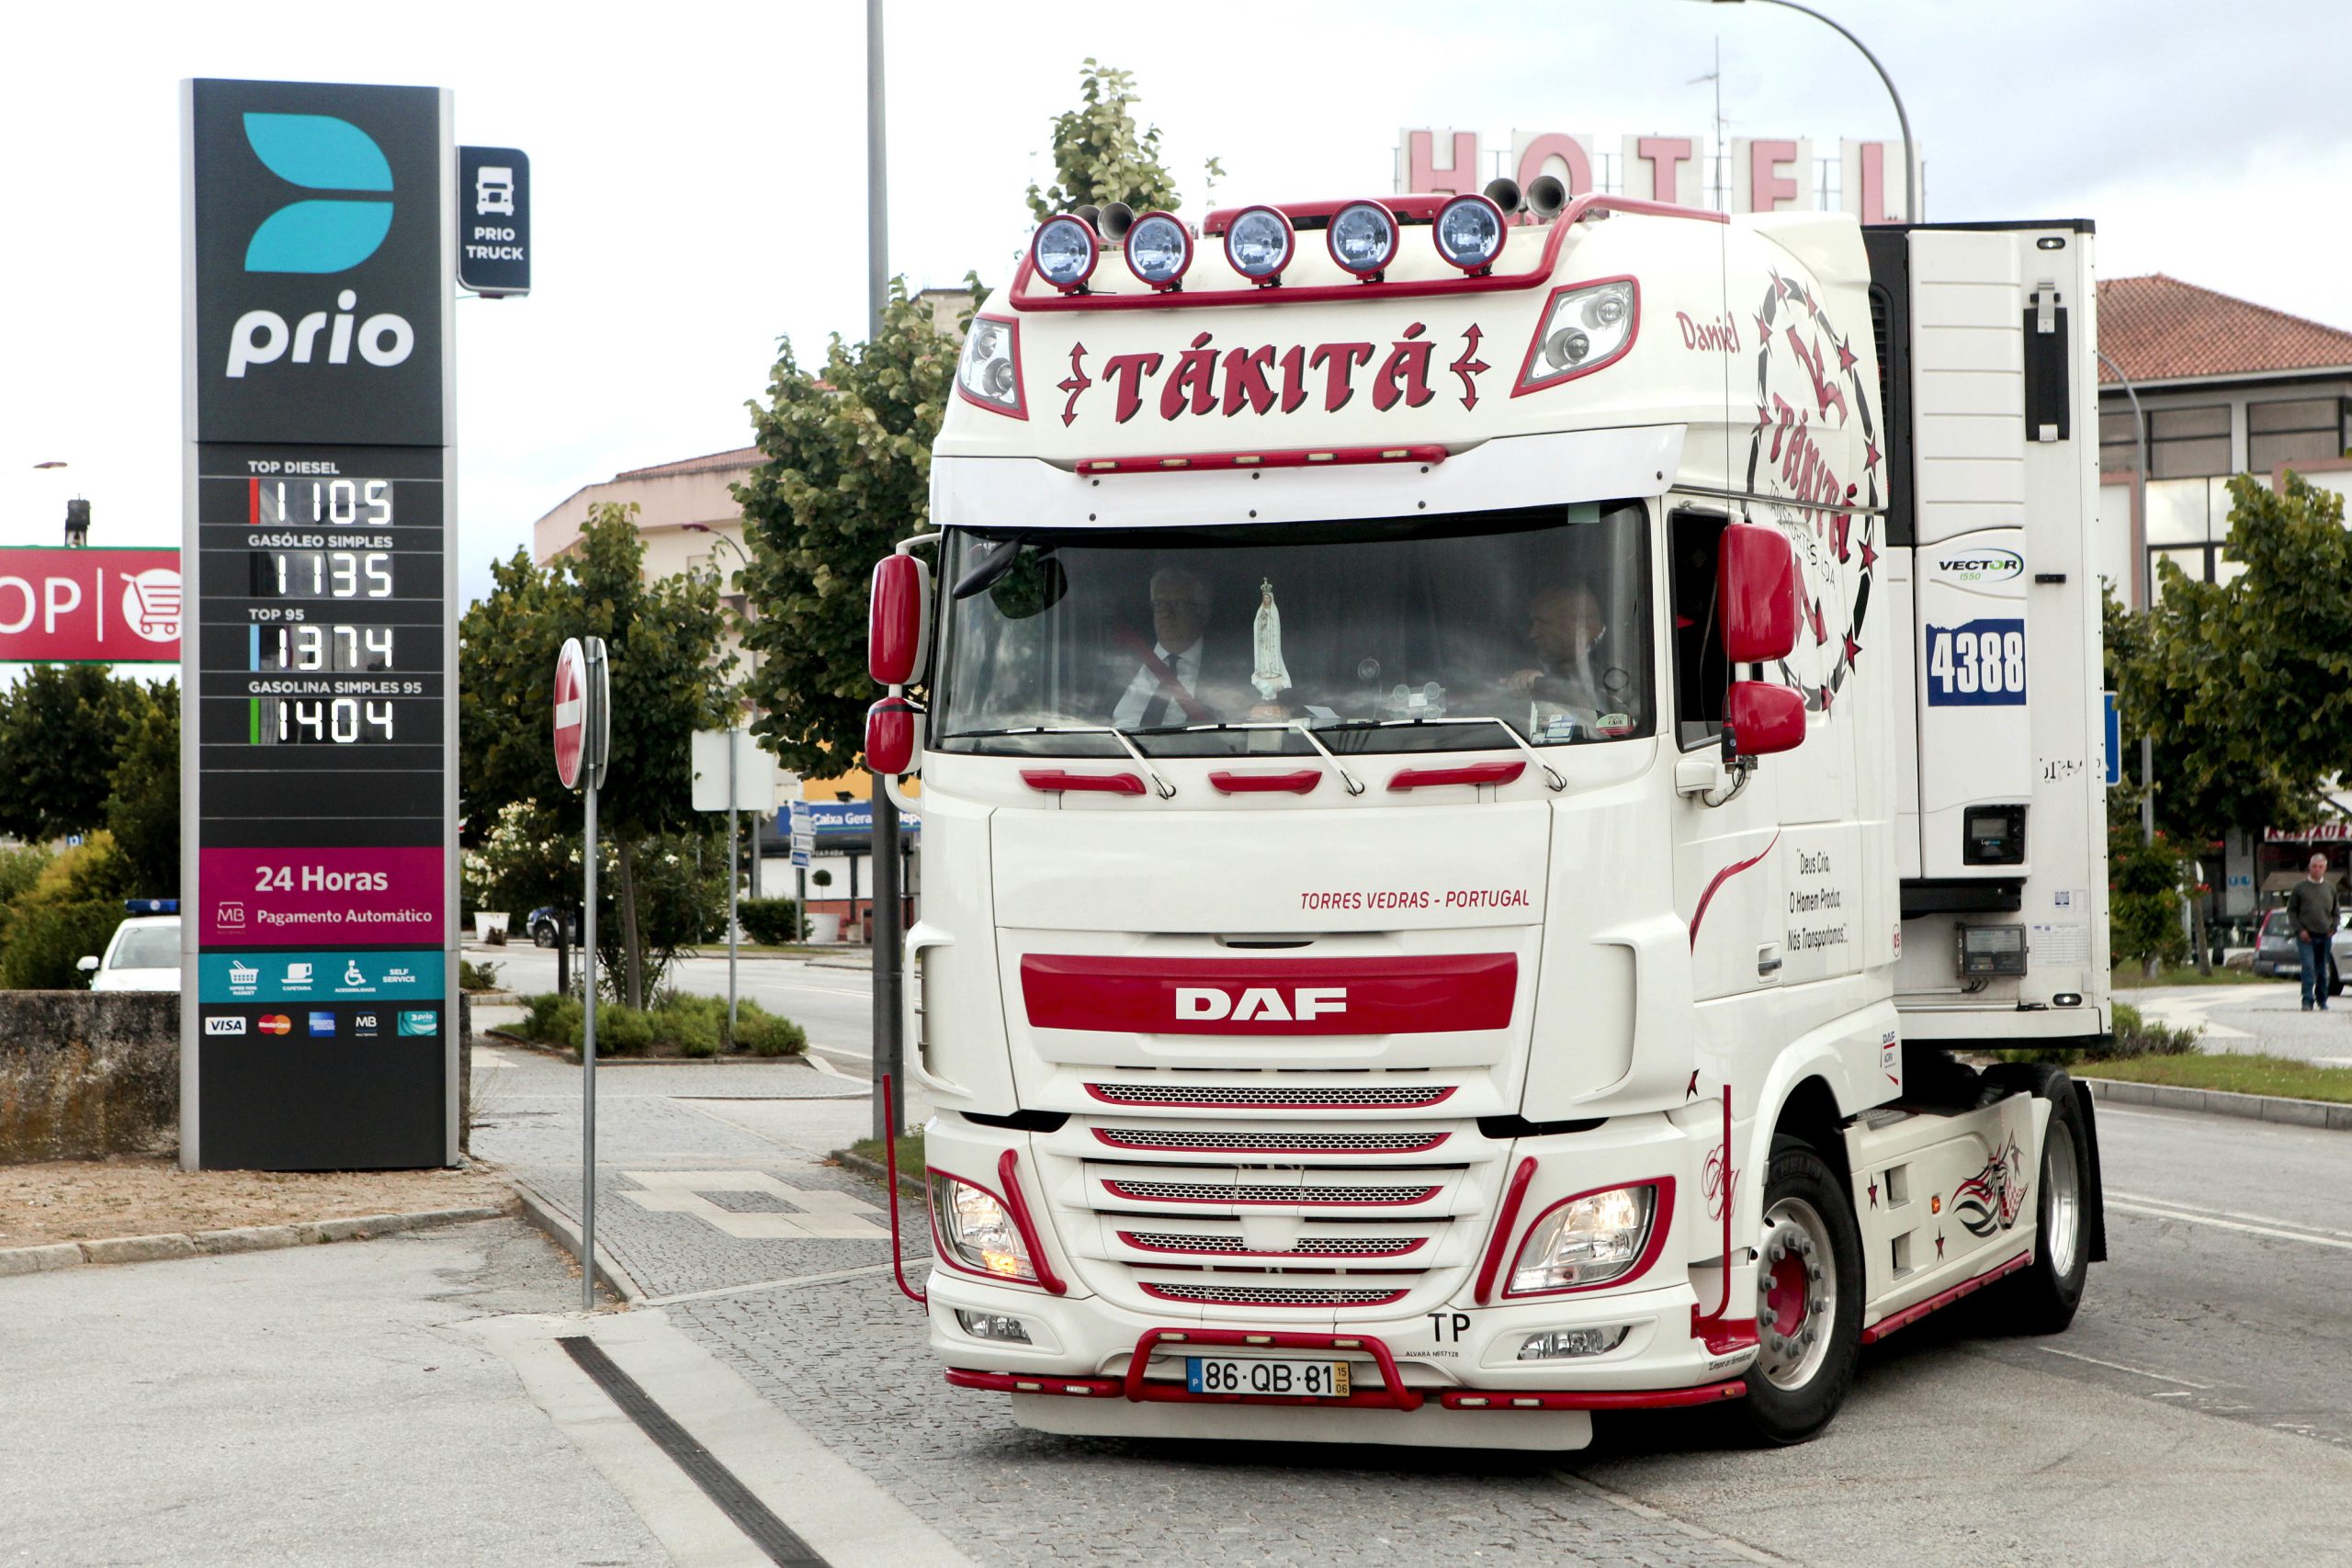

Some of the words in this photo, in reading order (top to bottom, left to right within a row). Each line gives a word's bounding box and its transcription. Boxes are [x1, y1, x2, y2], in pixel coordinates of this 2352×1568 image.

[474, 226, 515, 242] PRIO
[466, 245, 524, 261] TRUCK
[226, 289, 414, 378] prio
[1676, 310, 1741, 354] Daniel
[1102, 322, 1436, 423] TÁKITÁ
[248, 461, 280, 474] TOP
[285, 461, 340, 475] DIESEL
[248, 532, 324, 547] GASÓLEO
[328, 536, 393, 548] SIMPLES
[1939, 560, 2017, 570] VECTOR
[248, 608, 281, 621] TOP
[285, 609, 304, 621] 95
[279, 626, 392, 671] 1374
[1931, 632, 2023, 693] 4388
[248, 681, 331, 694] GASOLINA
[334, 682, 399, 694] SIMPLES
[402, 682, 423, 694] 95
[279, 698, 393, 743] 1404
[813, 813, 843, 825] Caixa
[844, 813, 872, 825] Gera
[254, 866, 294, 892] 24
[301, 865, 389, 892] Horas
[1302, 892, 1362, 909] TORRES
[1367, 891, 1430, 908] VEDRAS
[1445, 889, 1530, 908] PORTUGAL
[1790, 891, 1795, 913] O
[1796, 890, 1819, 913] Homem
[218, 908, 245, 921] MB
[257, 909, 342, 926] Pagamento
[345, 908, 433, 923] Automático
[1788, 929, 1801, 951] Nós
[1176, 987, 1346, 1021] DAF
[210, 1020, 243, 1031] VISA
[356, 1016, 377, 1027] MB
[1427, 1314, 1470, 1342] TP
[1193, 1379, 1198, 1387] P
[1338, 1367, 1347, 1377] 15
[1336, 1384, 1347, 1393] 06
